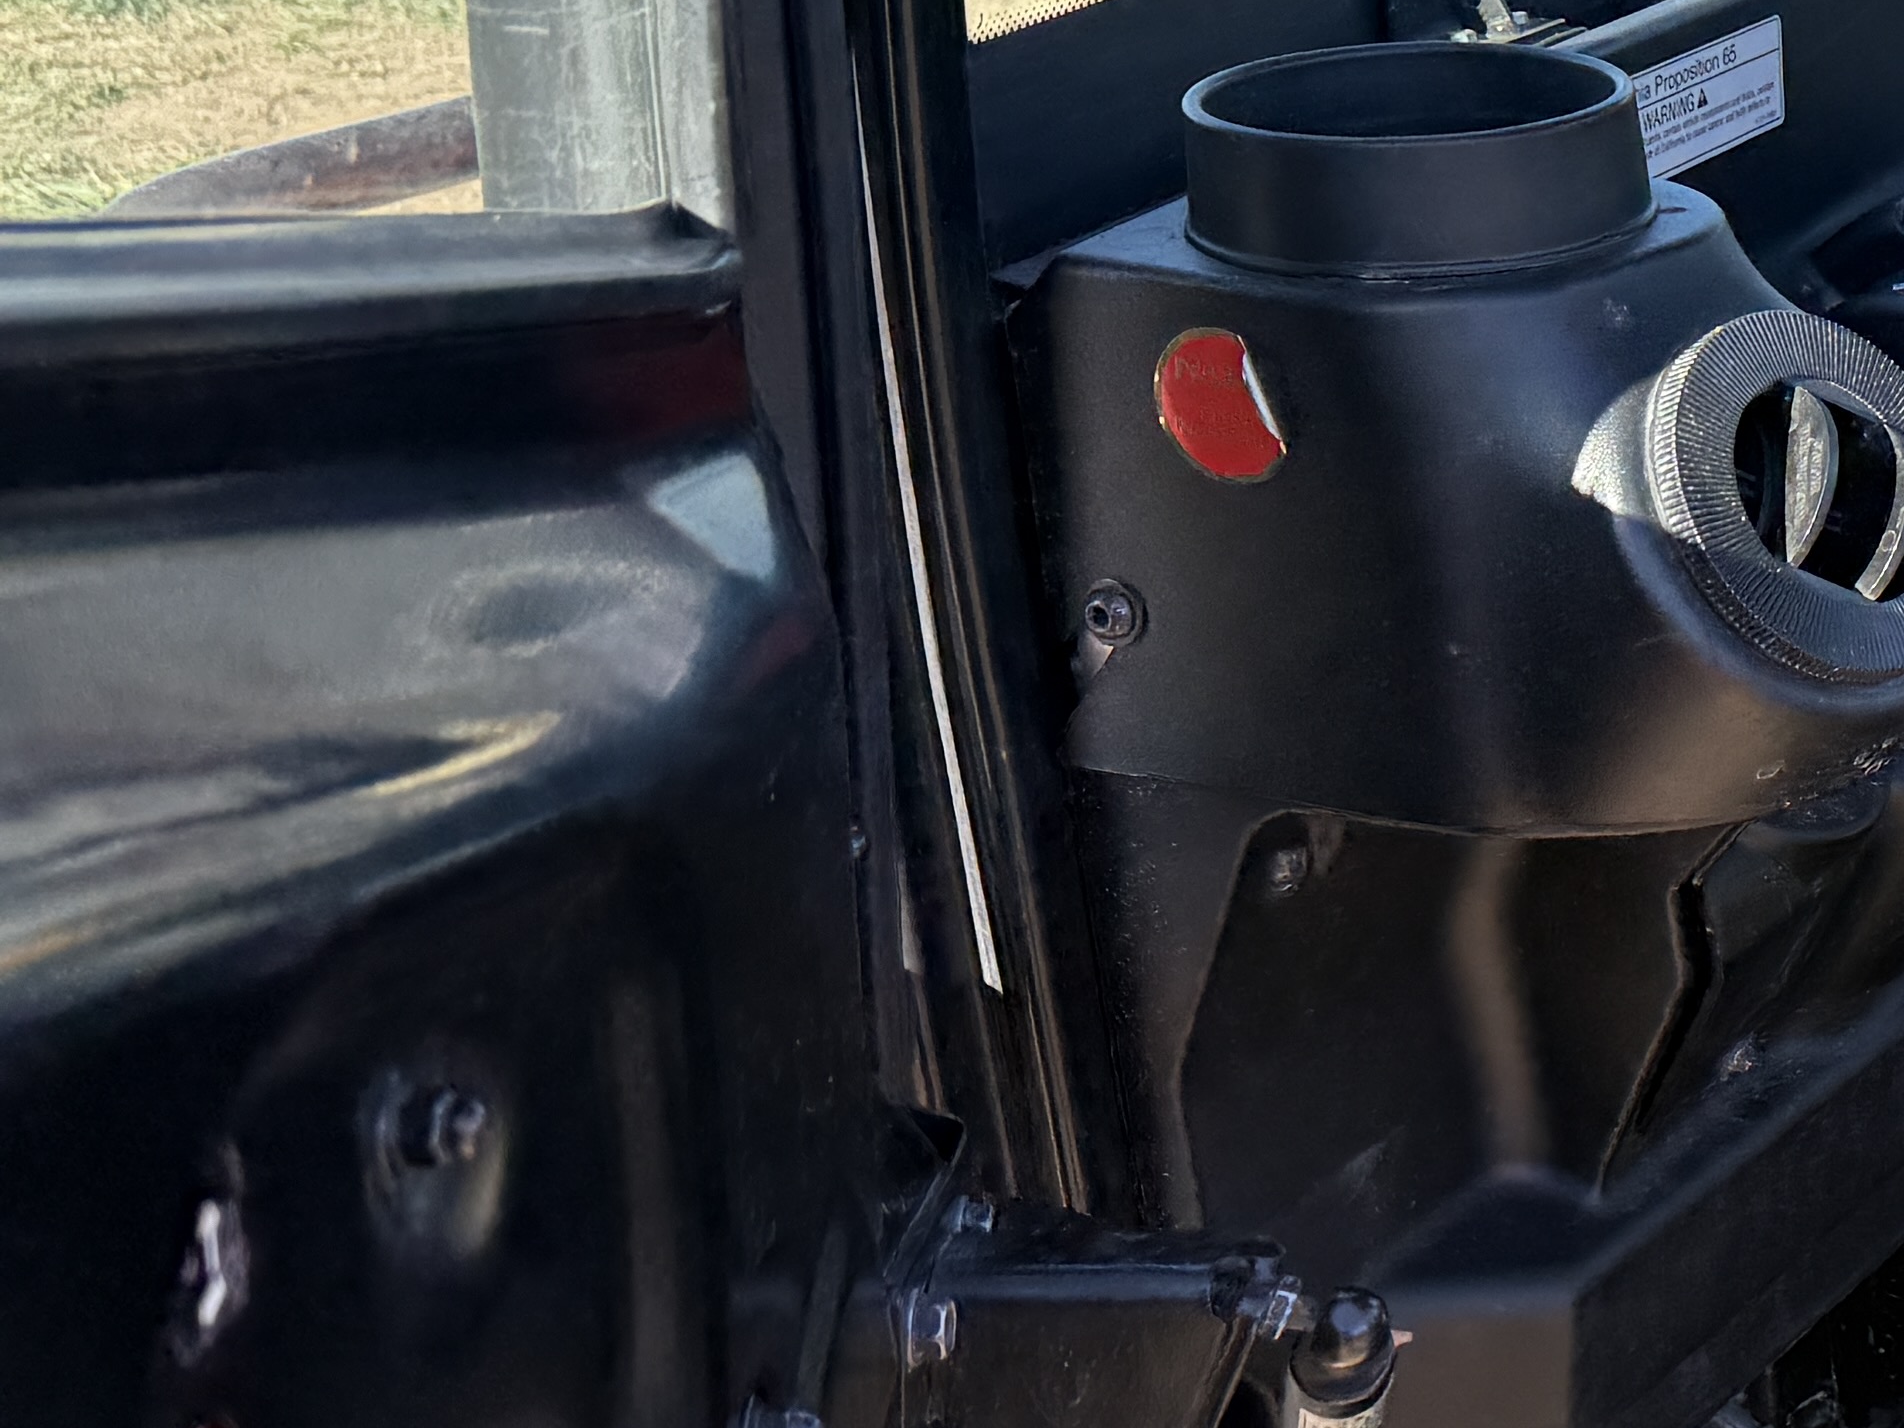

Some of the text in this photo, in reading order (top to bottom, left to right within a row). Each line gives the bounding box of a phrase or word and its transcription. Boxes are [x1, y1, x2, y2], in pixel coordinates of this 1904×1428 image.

[1654, 55, 1720, 96] Proposition
[1722, 43, 1737, 66] 65
[1641, 93, 1696, 133] WARNING
